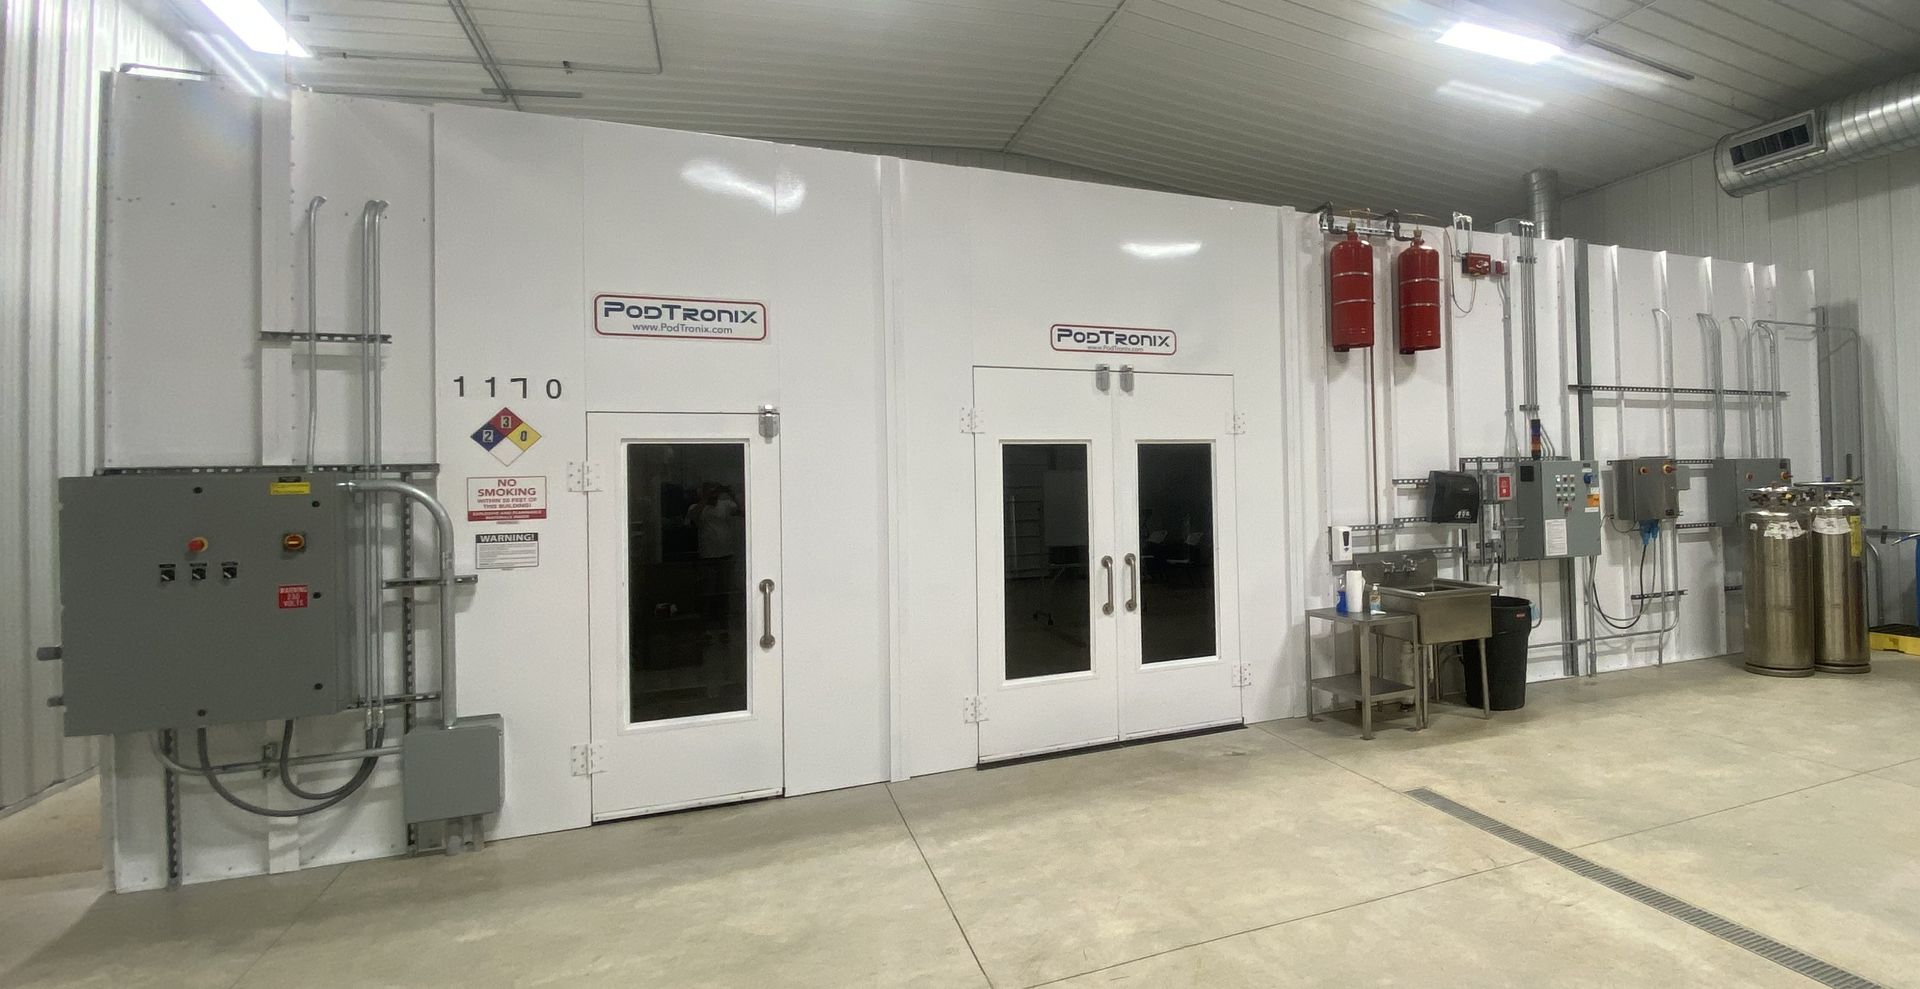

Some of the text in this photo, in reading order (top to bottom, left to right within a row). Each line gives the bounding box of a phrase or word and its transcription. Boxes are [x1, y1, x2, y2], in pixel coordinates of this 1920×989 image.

[632, 322, 733, 334] www.PodTronix.com
[453, 376, 562, 399] 1170
[502, 416, 510, 428] 3
[484, 430, 492, 442] 2
[520, 430, 528, 442] 0
[497, 479, 517, 487] NO
[478, 487, 537, 497] SMOKING
[480, 533, 535, 542] WARNING!
